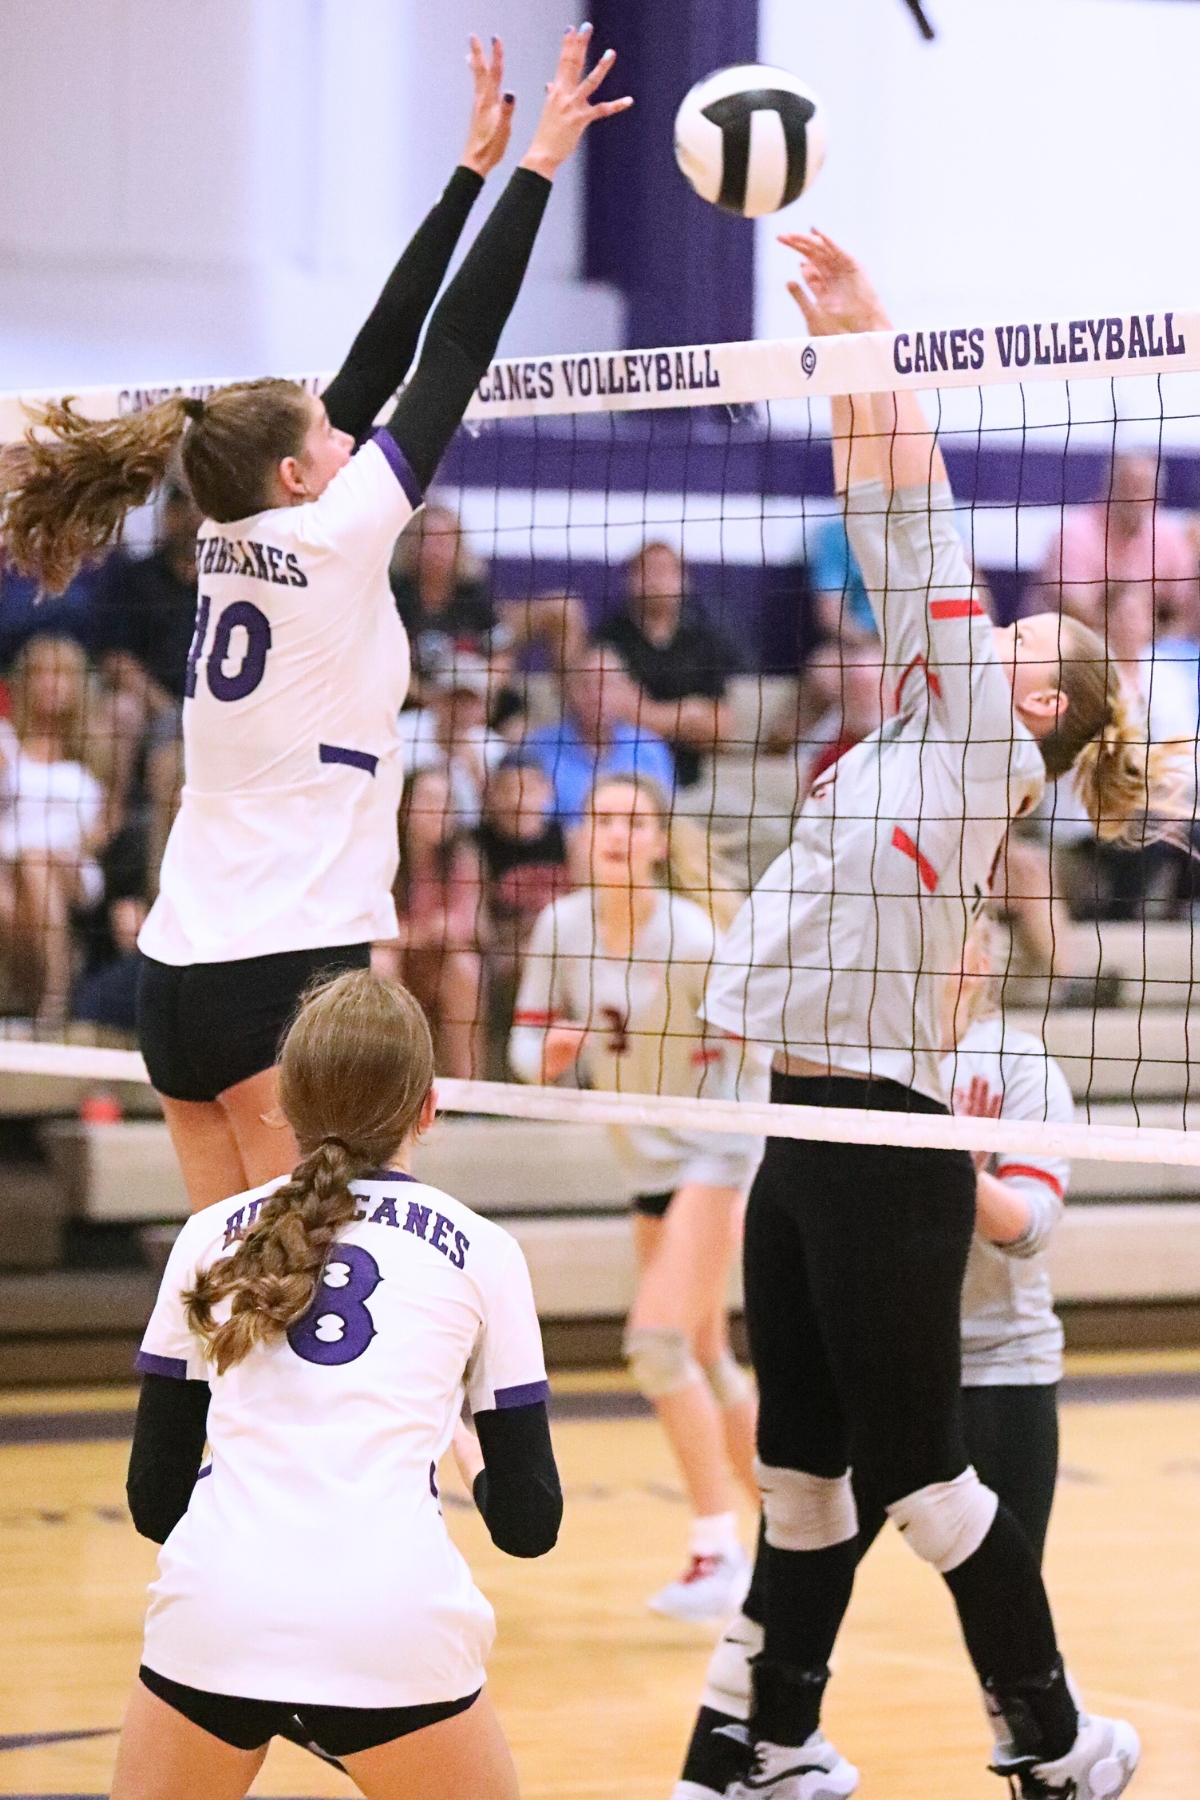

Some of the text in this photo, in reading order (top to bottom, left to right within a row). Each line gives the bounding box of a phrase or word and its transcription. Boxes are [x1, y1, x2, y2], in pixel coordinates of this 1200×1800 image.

[478, 350, 720, 402] CANES VOLLEYBALL
[893, 312, 1186, 374] CANES VOLLEYBALL
[184, 595, 272, 702] 10
[288, 1243, 385, 1366] 8
